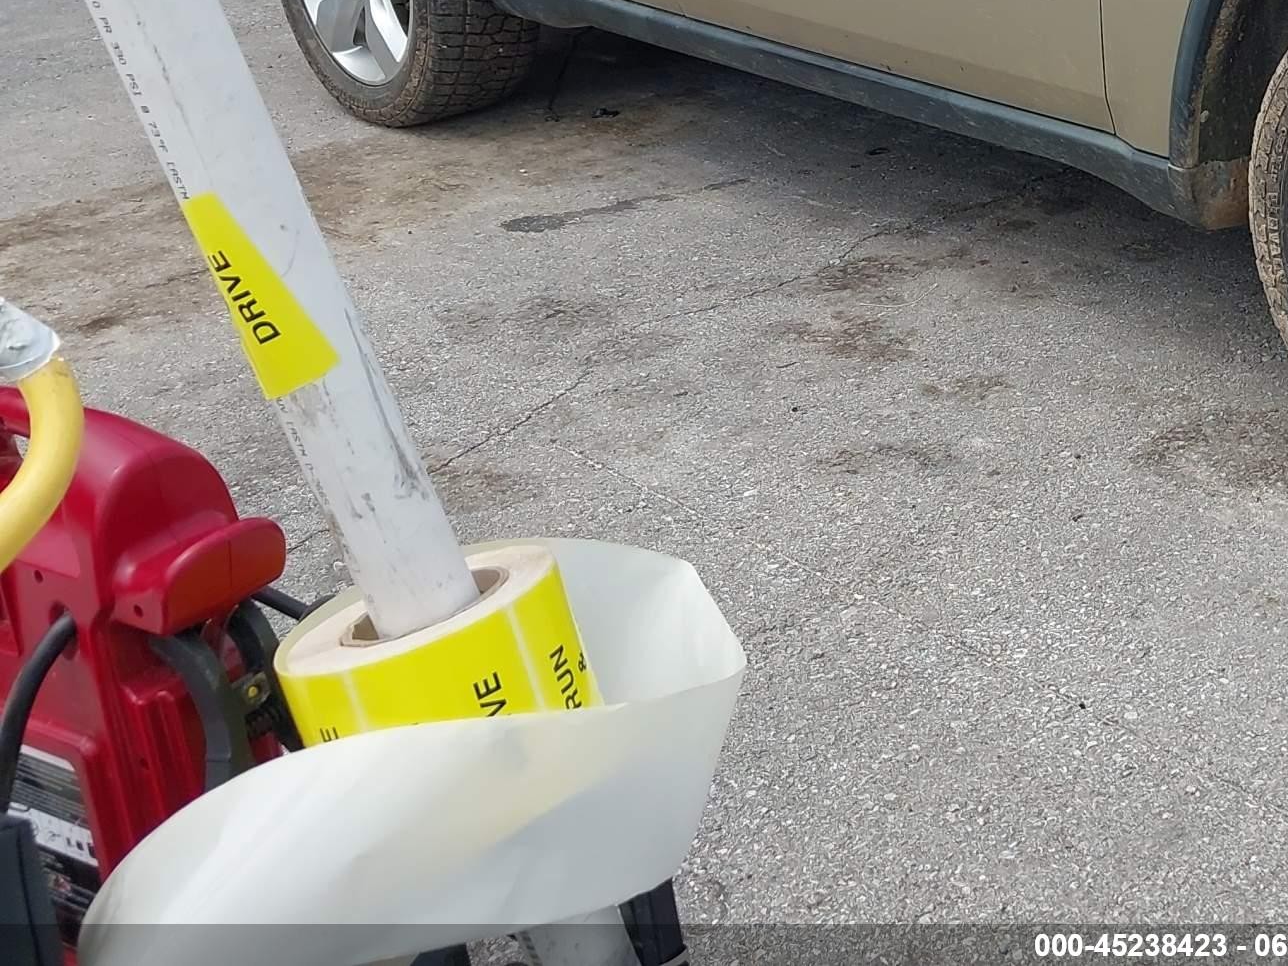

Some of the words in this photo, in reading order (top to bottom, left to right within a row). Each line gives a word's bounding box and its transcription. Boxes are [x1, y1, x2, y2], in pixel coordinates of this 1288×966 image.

[99, 17, 112, 34] PR
[126, 73, 143, 96] PSI
[207, 250, 282, 344] DRIVE
[549, 644, 582, 710] RUN
